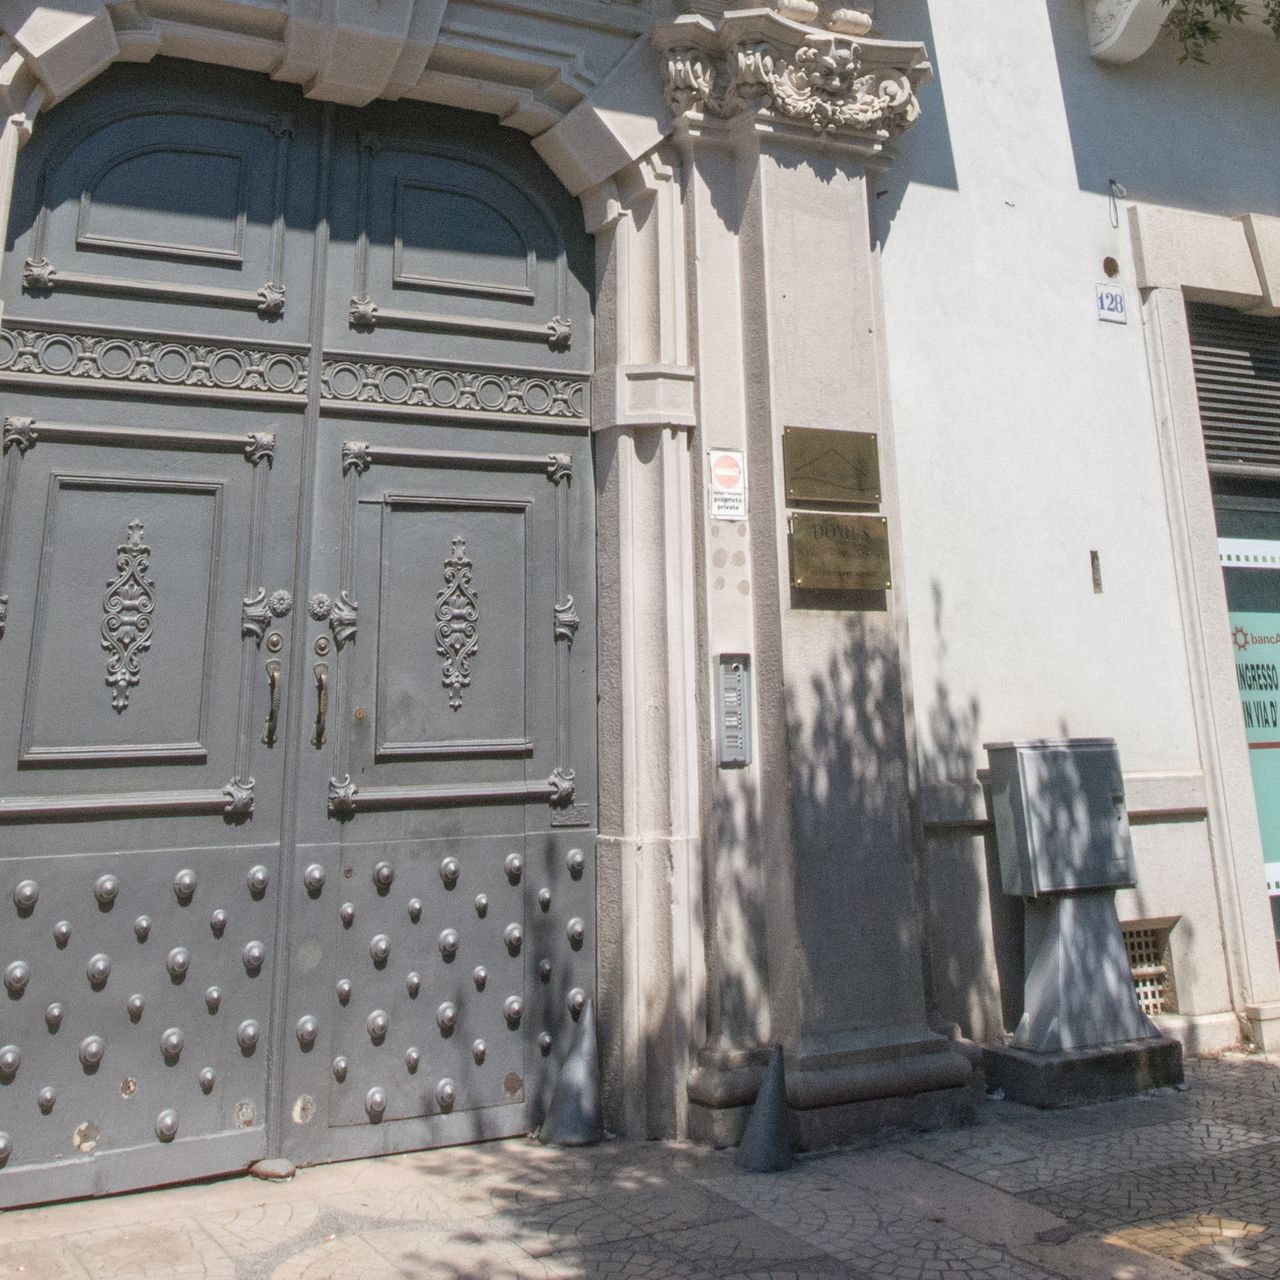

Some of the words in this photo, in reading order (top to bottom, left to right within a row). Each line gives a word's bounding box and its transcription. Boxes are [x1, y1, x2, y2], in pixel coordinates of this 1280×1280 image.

[1099, 292, 1124, 313] 128
[1235, 663, 1279, 691] INGRESSO
[1242, 701, 1254, 728] IN
[1253, 700, 1270, 728] VIA
